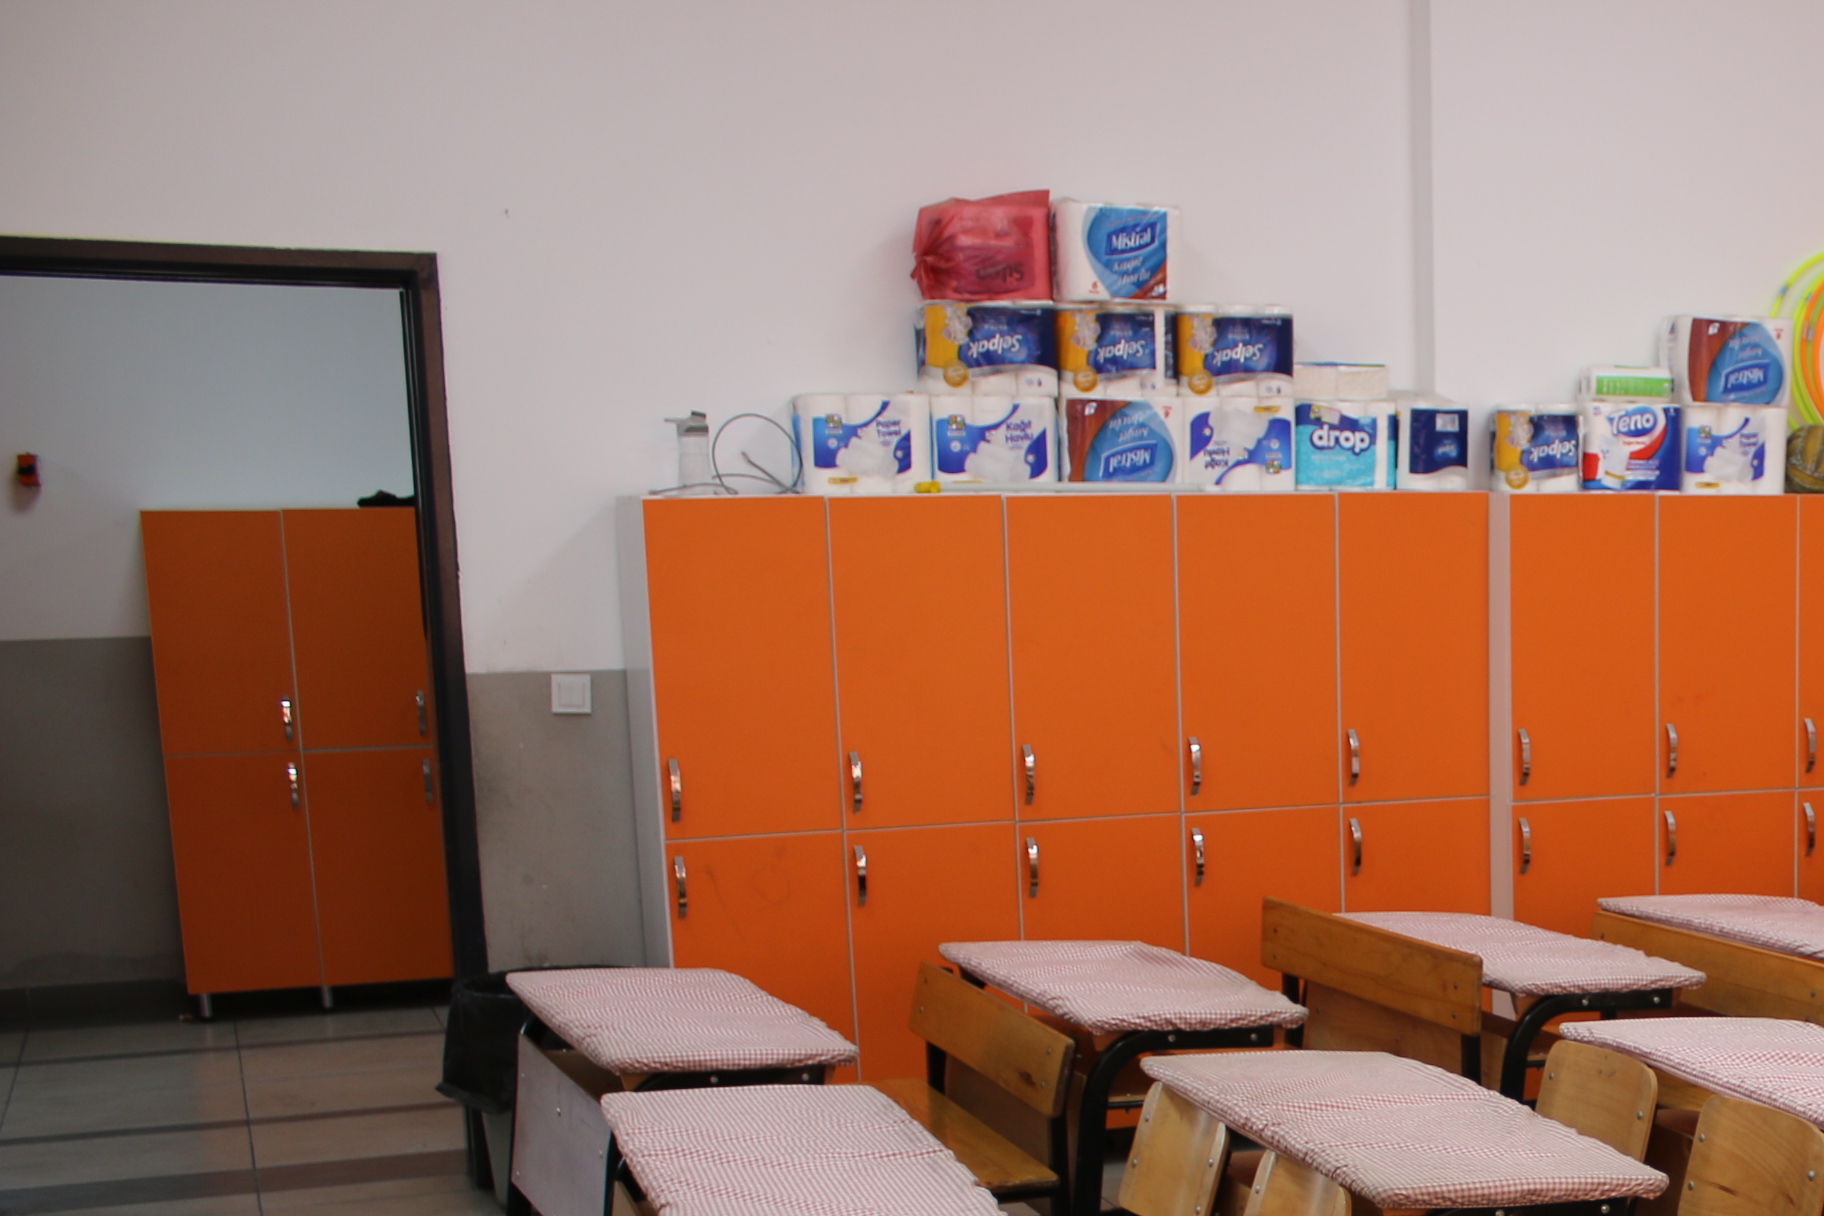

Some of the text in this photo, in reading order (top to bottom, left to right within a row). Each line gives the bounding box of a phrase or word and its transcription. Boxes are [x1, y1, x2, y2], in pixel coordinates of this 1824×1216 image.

[1111, 226, 1152, 251] Mistral
[968, 333, 1023, 359] Selpak
[1096, 338, 1147, 364] Selpak
[1212, 342, 1264, 368] Selpak
[1726, 367, 1765, 389] Mistral
[1608, 409, 1654, 435] Teno
[1311, 424, 1372, 454] drop
[1529, 439, 1577, 463] Selpak
[1108, 448, 1152, 474] Mistral
